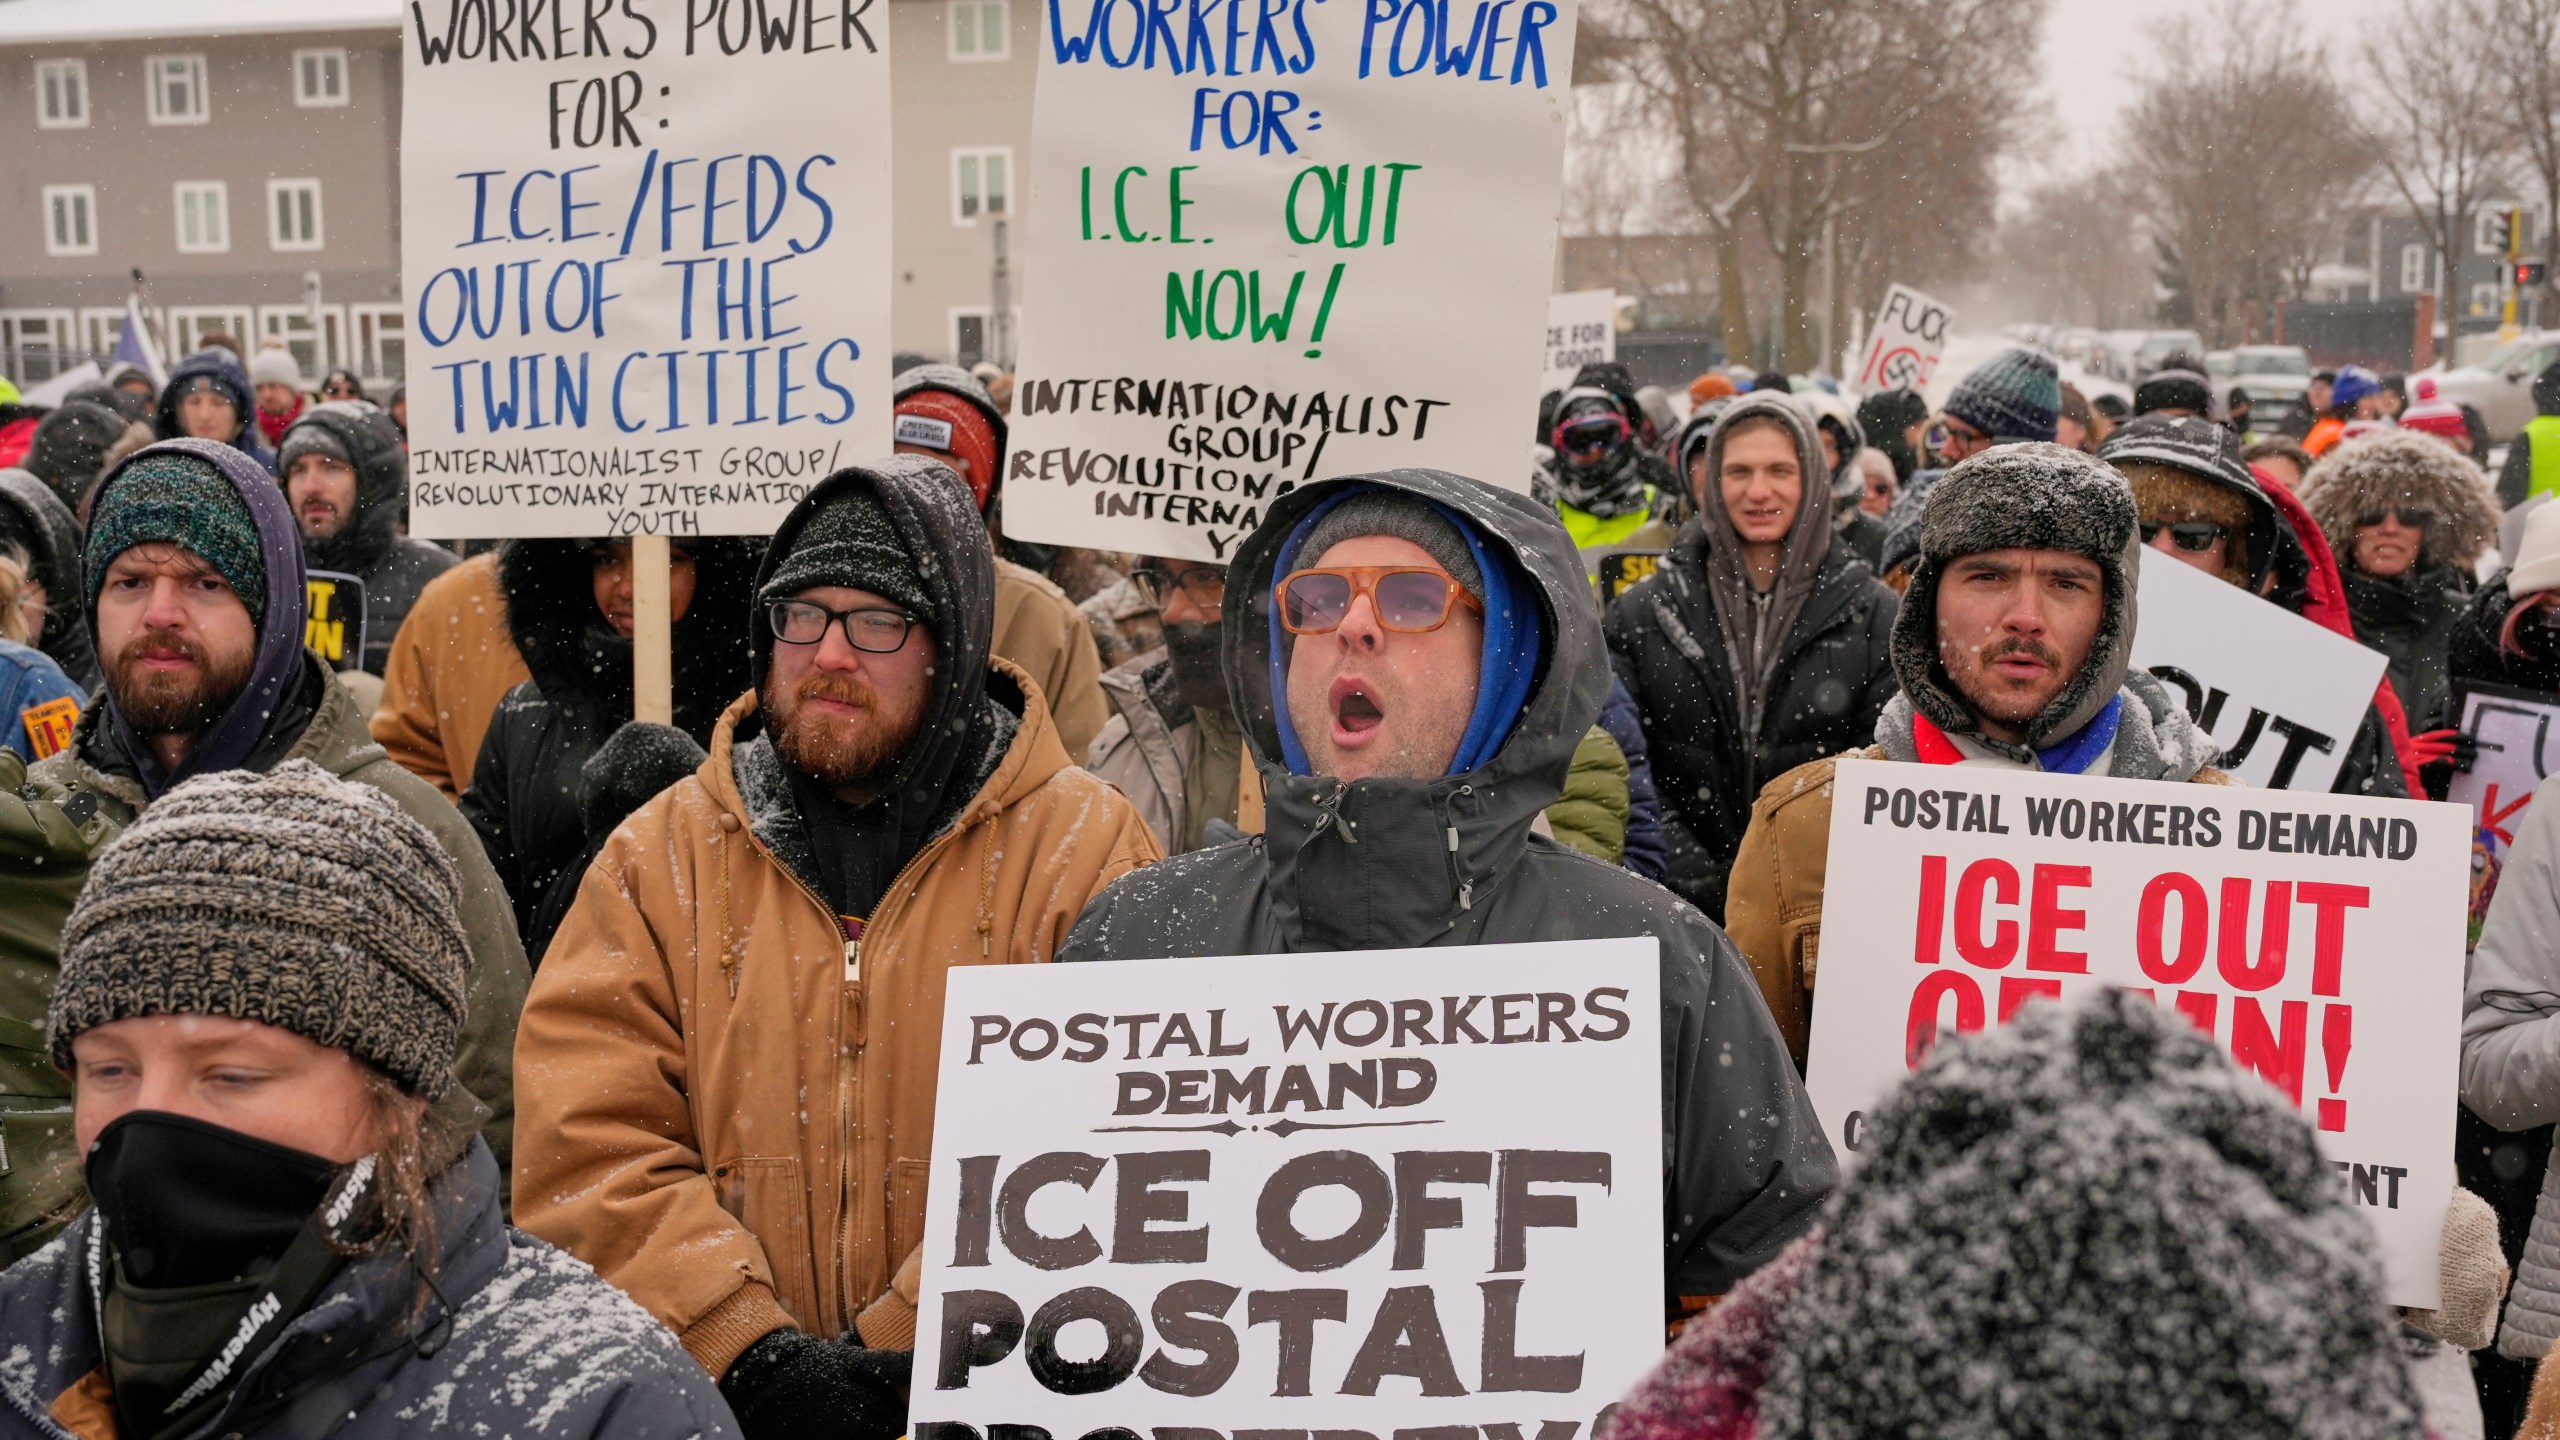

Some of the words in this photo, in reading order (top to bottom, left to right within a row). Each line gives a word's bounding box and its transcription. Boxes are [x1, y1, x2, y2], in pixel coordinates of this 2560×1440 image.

[412, 0, 657, 65] WORKERS
[685, 0, 878, 56] POWER
[1048, 0, 1326, 77] WORKERS
[1358, 0, 1558, 88] POWER
[549, 70, 670, 149] FOR:
[1190, 88, 1322, 156] FOR:
[1081, 165, 1215, 244] I.C.E.
[1285, 162, 1423, 249] OUT
[661, 254, 802, 341] THE
[1165, 262, 1346, 359] NOW!
[1572, 322, 1605, 344] FOR
[431, 351, 589, 434] TWIN
[611, 338, 861, 433] CITIES
[1021, 378, 1451, 440] INTERNATIONALIST
[413, 447, 702, 478] INTERNATIONALIST
[719, 440, 841, 479] GROUP/
[1168, 423, 1331, 479] GROUP/
[415, 482, 629, 508] REVOLUTIONARY
[640, 483, 812, 506] INTERNATIO
[608, 508, 700, 537] YOUTH
[1863, 787, 2010, 834] POSTAL
[2024, 797, 2223, 847] WORKERS
[2237, 809, 2418, 861] DEMAND
[1914, 854, 2093, 974] ICE
[2136, 871, 2370, 997] OUT
[966, 1009, 1249, 1065] POSTAL
[1273, 986, 1631, 1053] WORKERS
[1112, 1058, 1438, 1116] DEMAND
[947, 1150, 1211, 1271] ICE
[1256, 1149, 1612, 1273] OFF
[935, 1279, 1586, 1398] POSTAL
